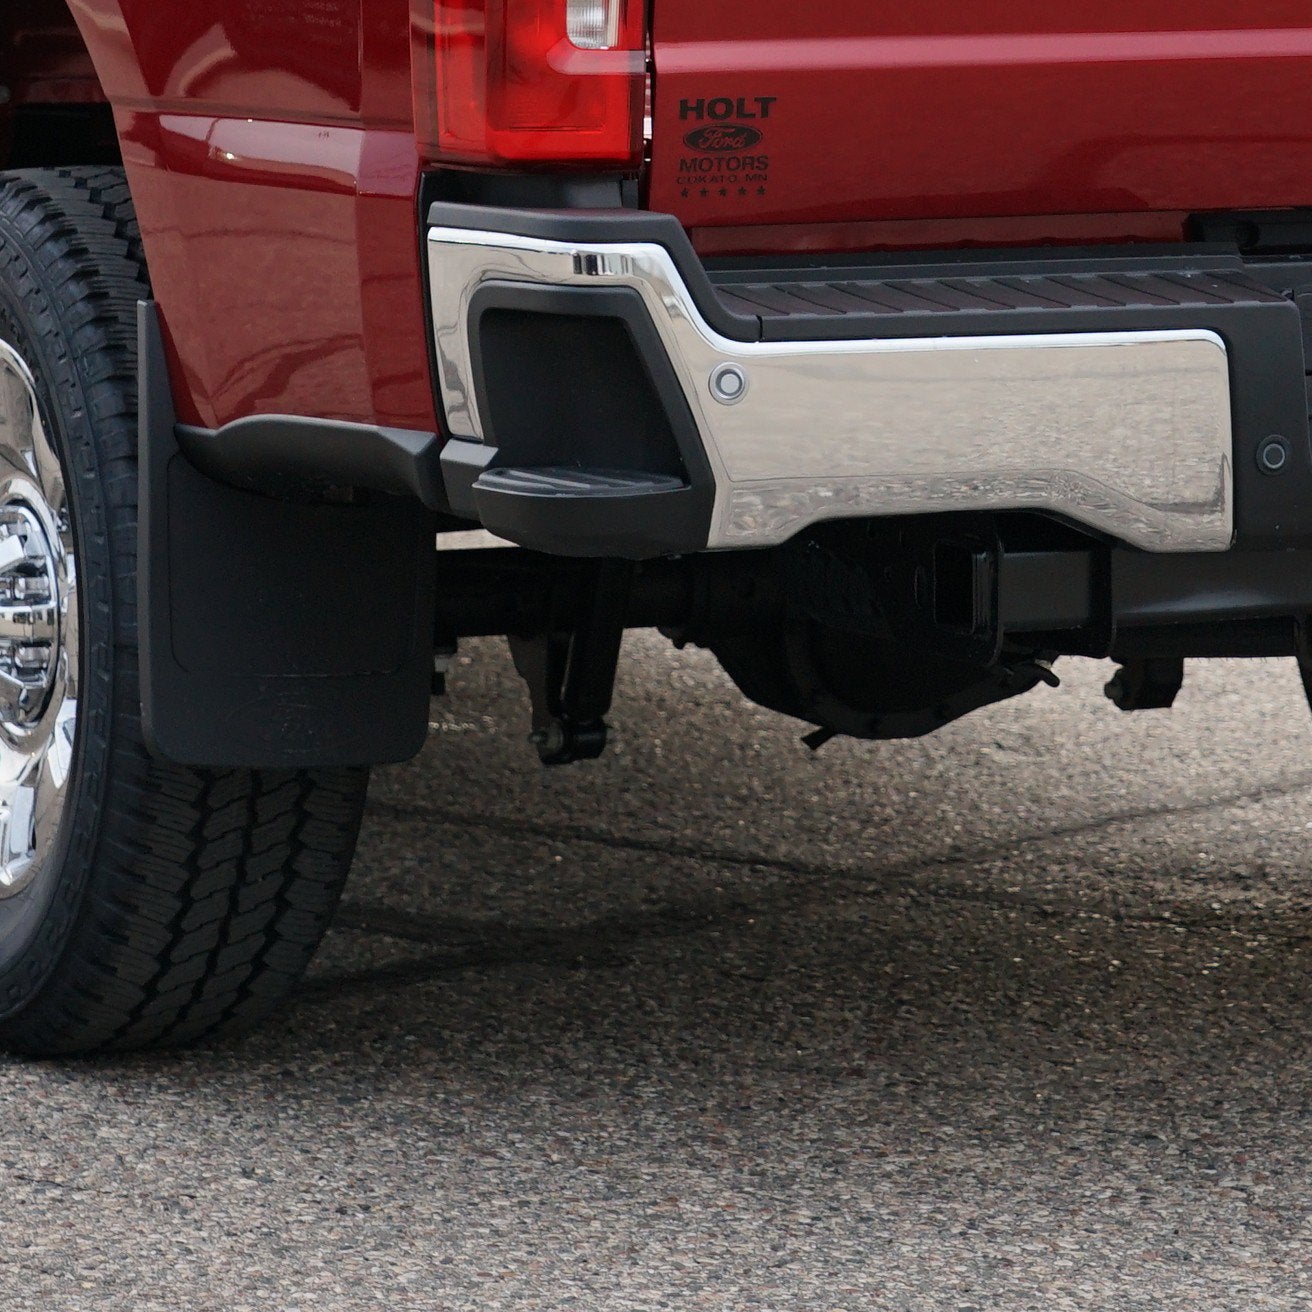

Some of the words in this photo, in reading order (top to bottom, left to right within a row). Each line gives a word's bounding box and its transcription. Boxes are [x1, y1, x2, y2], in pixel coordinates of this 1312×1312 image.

[679, 97, 777, 121] HOLT
[698, 126, 747, 150] Ford
[679, 155, 769, 172] MOTORS
